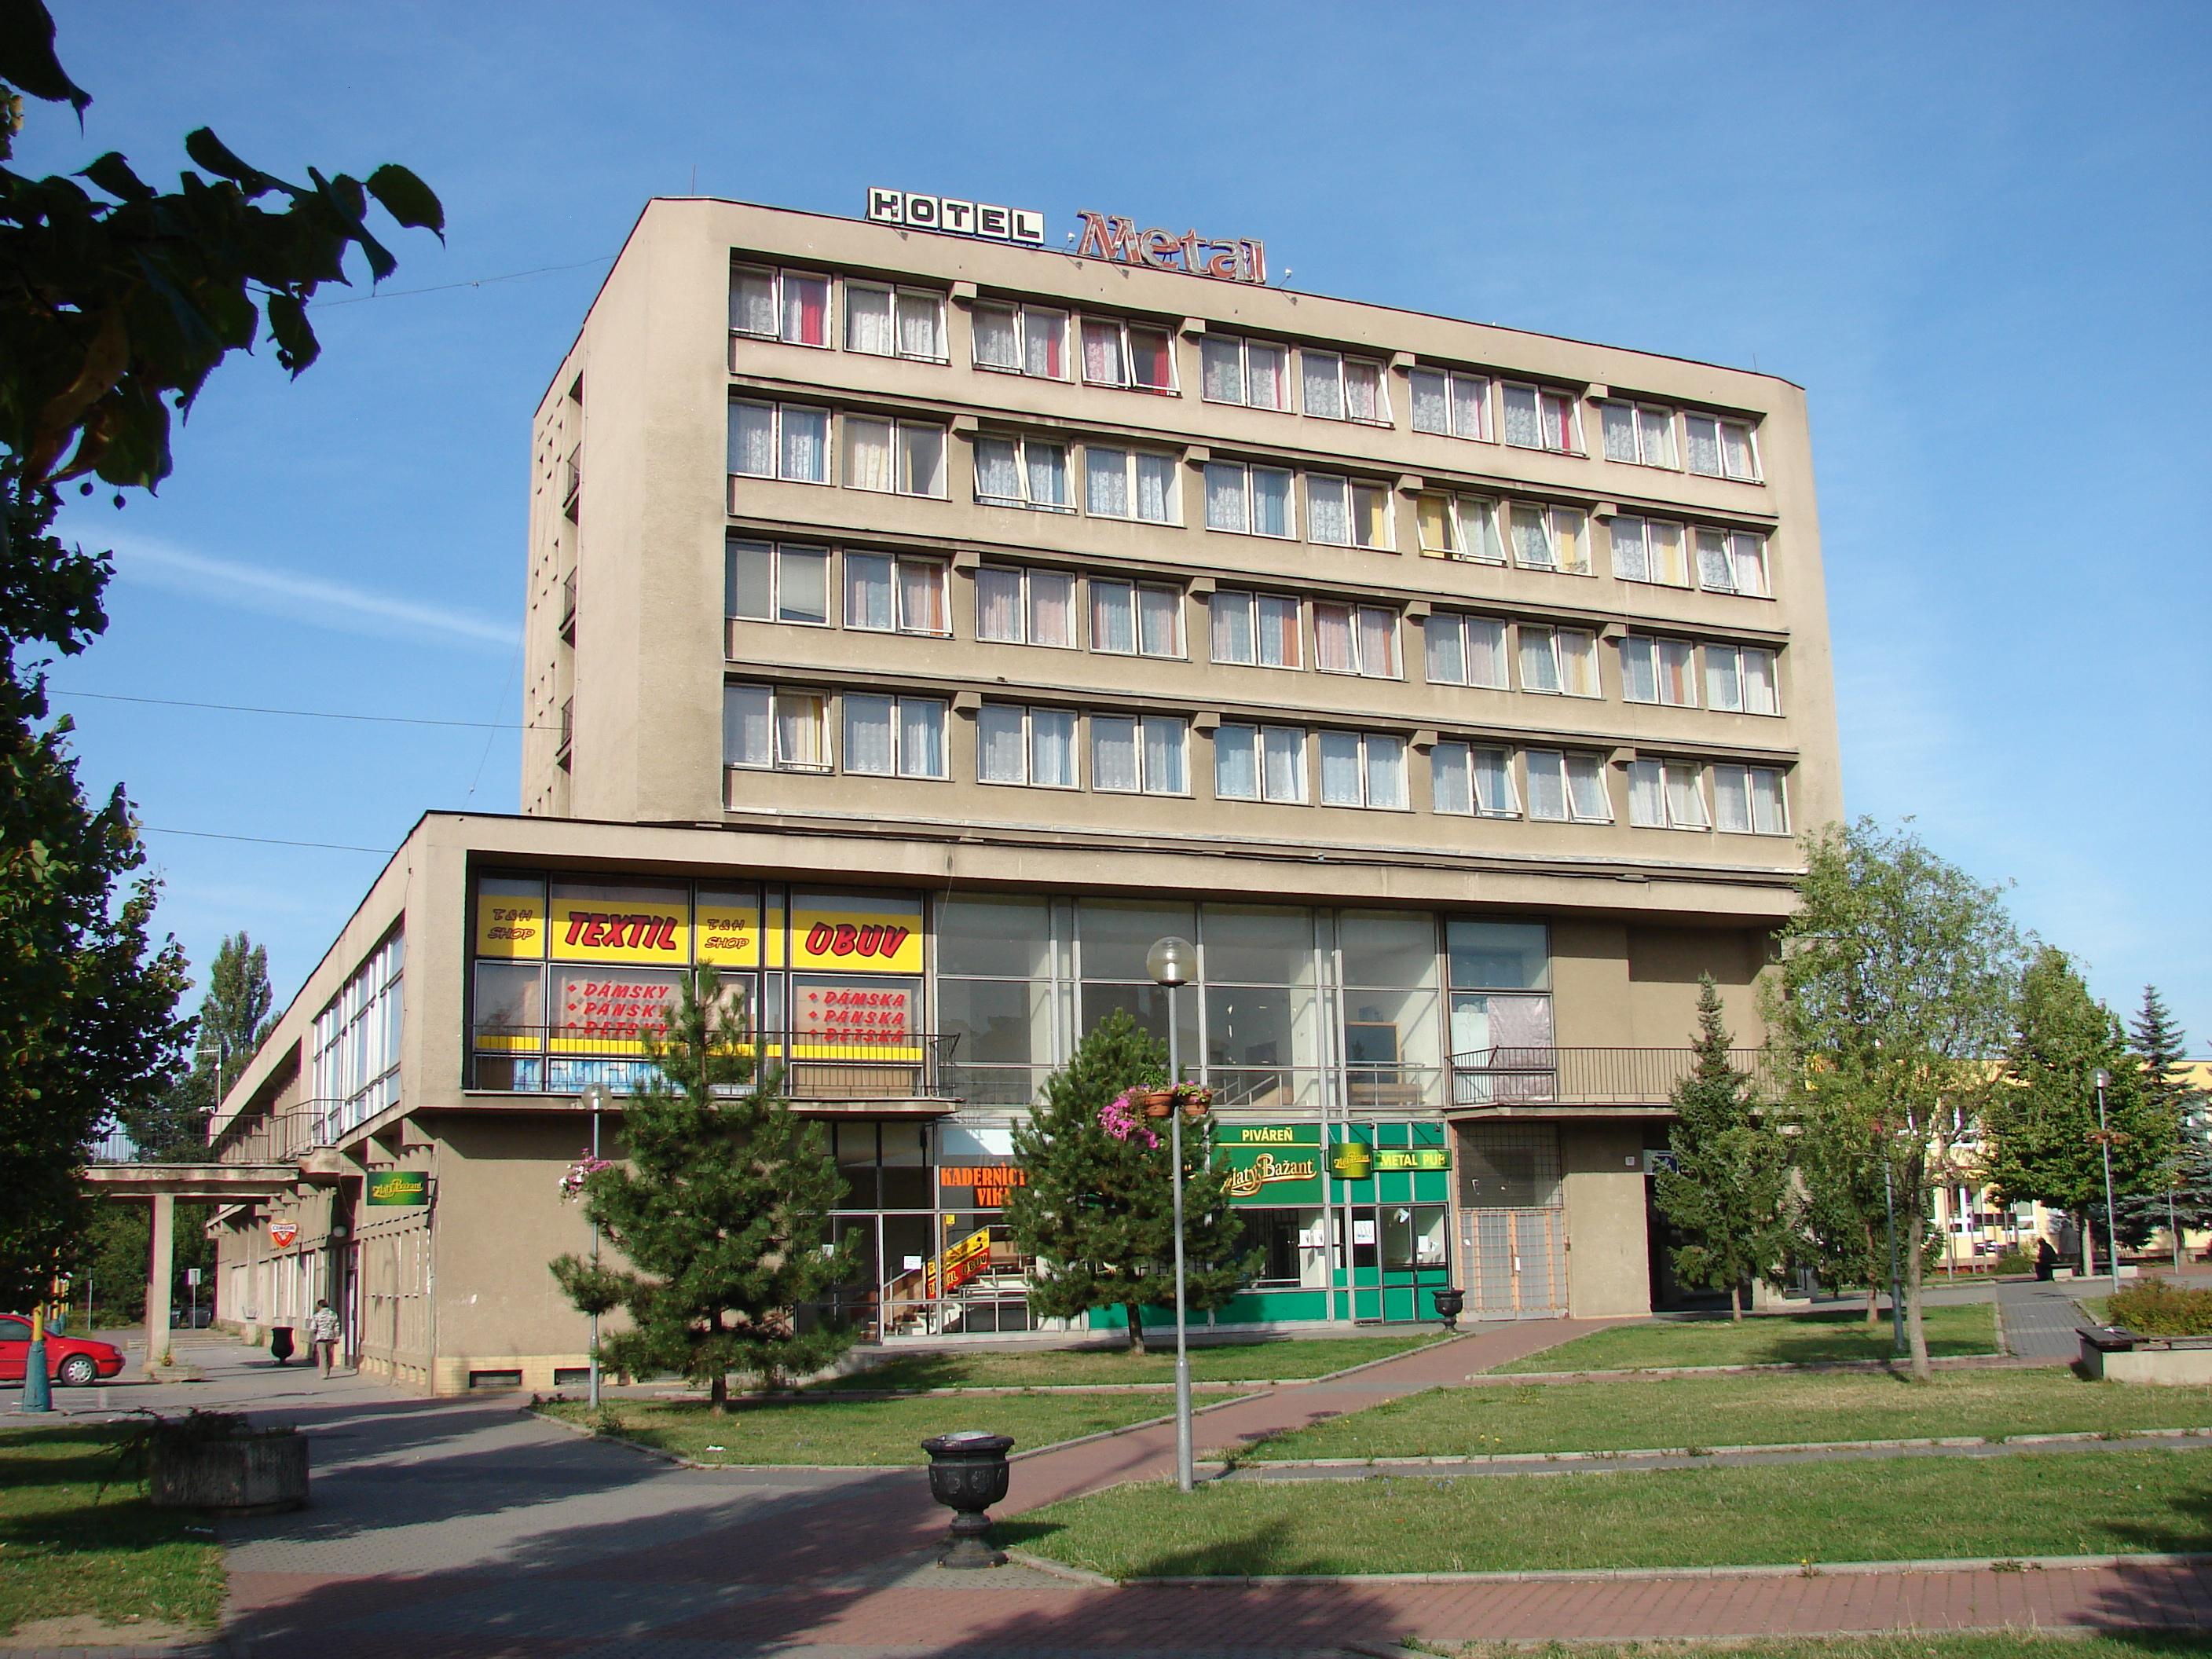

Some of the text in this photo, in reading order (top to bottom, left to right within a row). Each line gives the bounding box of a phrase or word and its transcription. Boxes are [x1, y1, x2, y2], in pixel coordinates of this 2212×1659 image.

[874, 192, 1267, 284] HOTEL Metal
[487, 926, 535, 940] SHOP
[565, 911, 678, 950] TEXTIL
[805, 922, 910, 958] OBUV
[705, 936, 749, 950] SHOP
[584, 980, 669, 999] DÁMSKY
[824, 988, 906, 1007] DÁMSKA
[584, 1000, 669, 1017] PÁNSKY
[824, 1007, 906, 1024] PÁNSKA
[1242, 1127, 1293, 1141] PIVÁREŇ
[1257, 1153, 1315, 1179] Bažant
[1380, 1154, 1445, 1166] METAL PUB
[962, 1252, 988, 1276] OBUV
